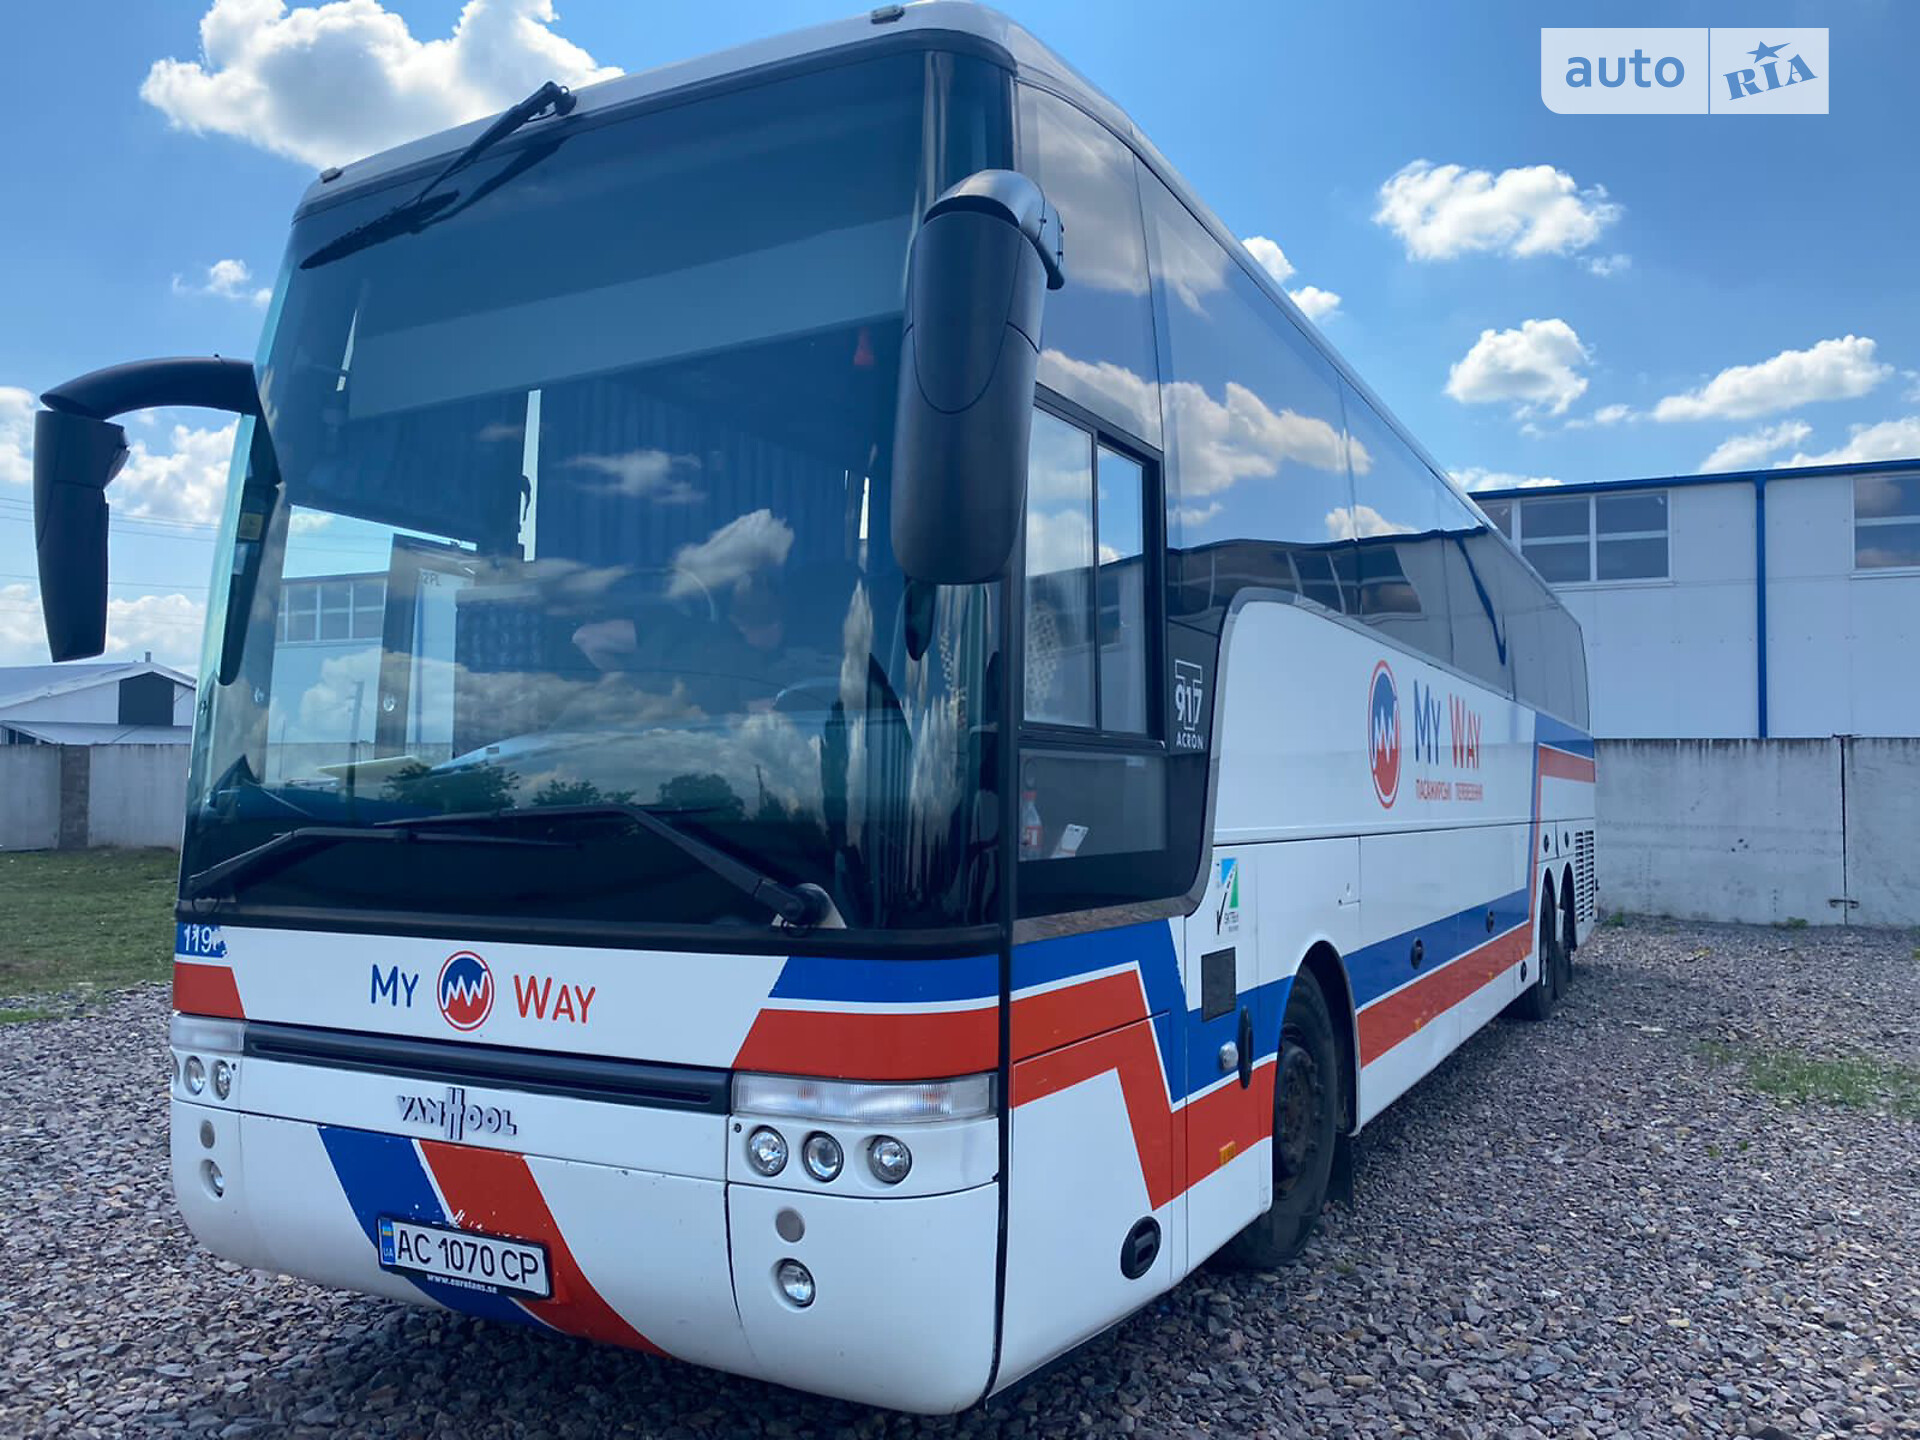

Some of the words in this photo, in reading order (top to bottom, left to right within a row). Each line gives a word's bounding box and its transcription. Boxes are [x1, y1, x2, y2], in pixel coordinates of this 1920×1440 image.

[1176, 731, 1204, 750] ACRON
[383, 1247, 394, 1258] UA
[438, 1237, 495, 1277] 1070
